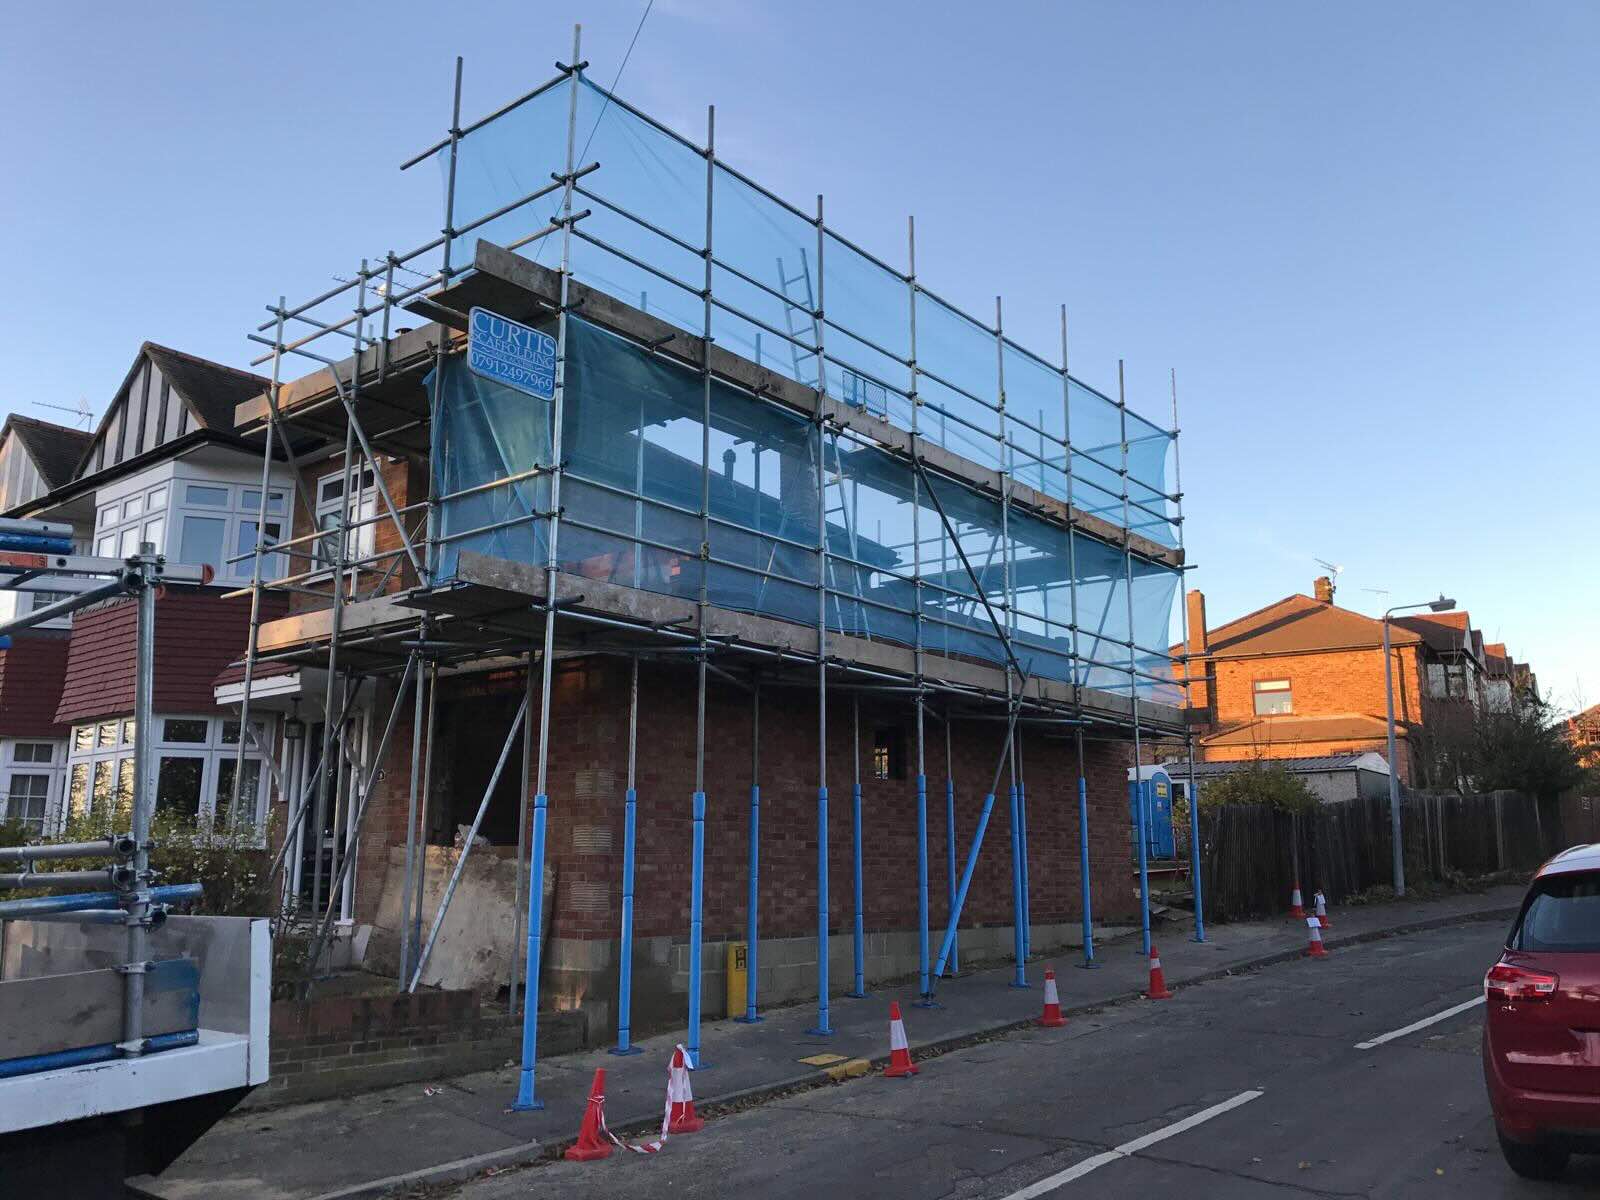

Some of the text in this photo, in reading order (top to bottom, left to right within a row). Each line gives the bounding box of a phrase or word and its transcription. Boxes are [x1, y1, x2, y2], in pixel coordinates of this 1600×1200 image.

[472, 330, 555, 369] SCAFFOLDING
[474, 312, 555, 357] CURTIS
[471, 351, 553, 391] 07912497969
